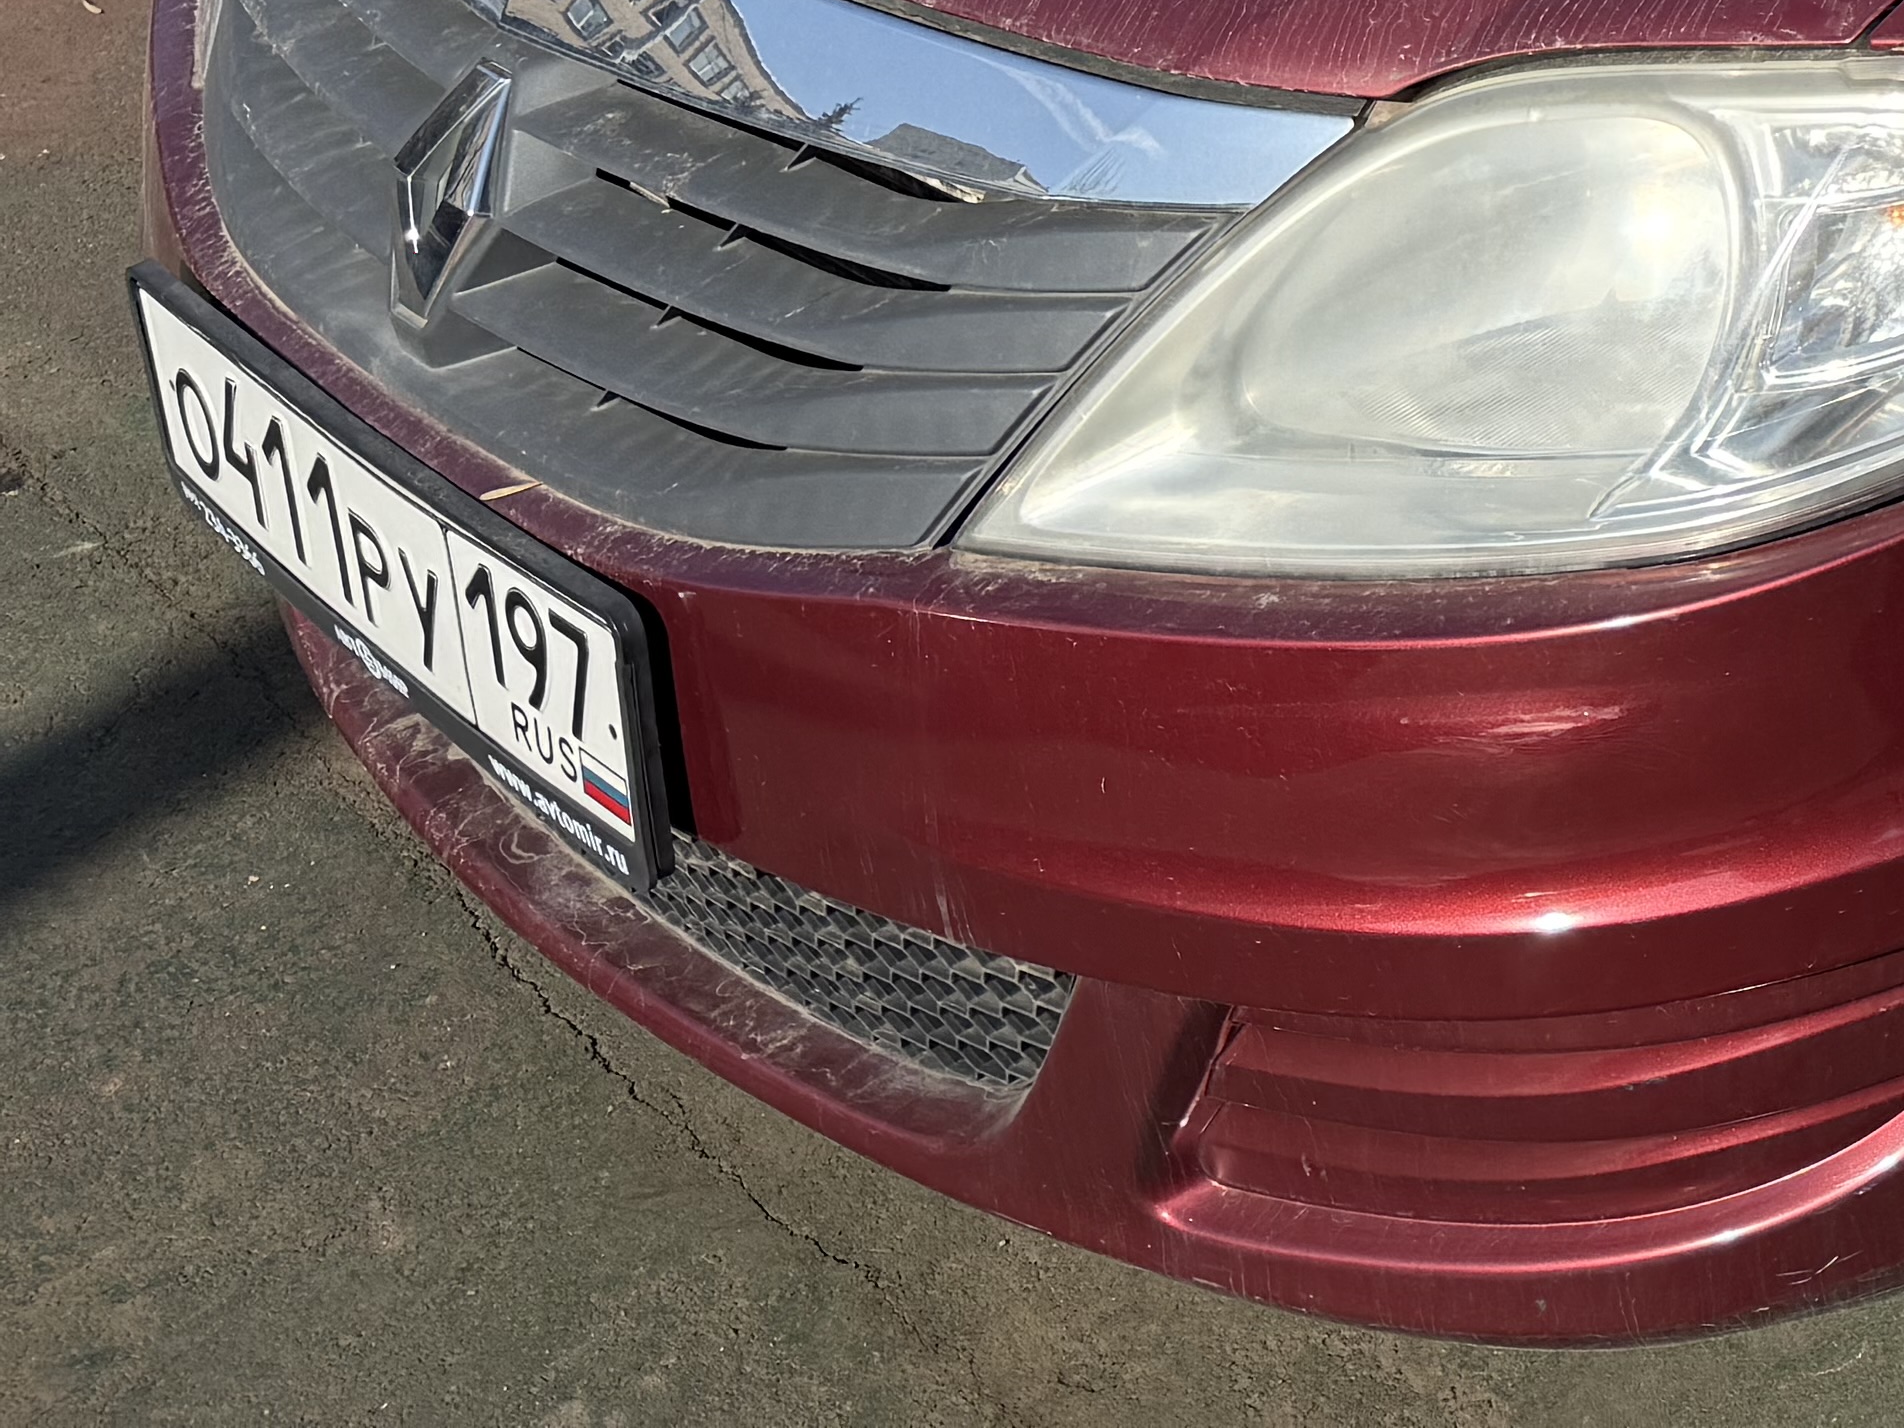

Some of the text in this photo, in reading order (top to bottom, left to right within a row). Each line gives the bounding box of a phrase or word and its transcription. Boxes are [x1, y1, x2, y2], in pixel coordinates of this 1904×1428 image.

[465, 563, 590, 744] 197
[511, 702, 577, 783] RUS
[488, 754, 630, 875] www.avtomir.ru
